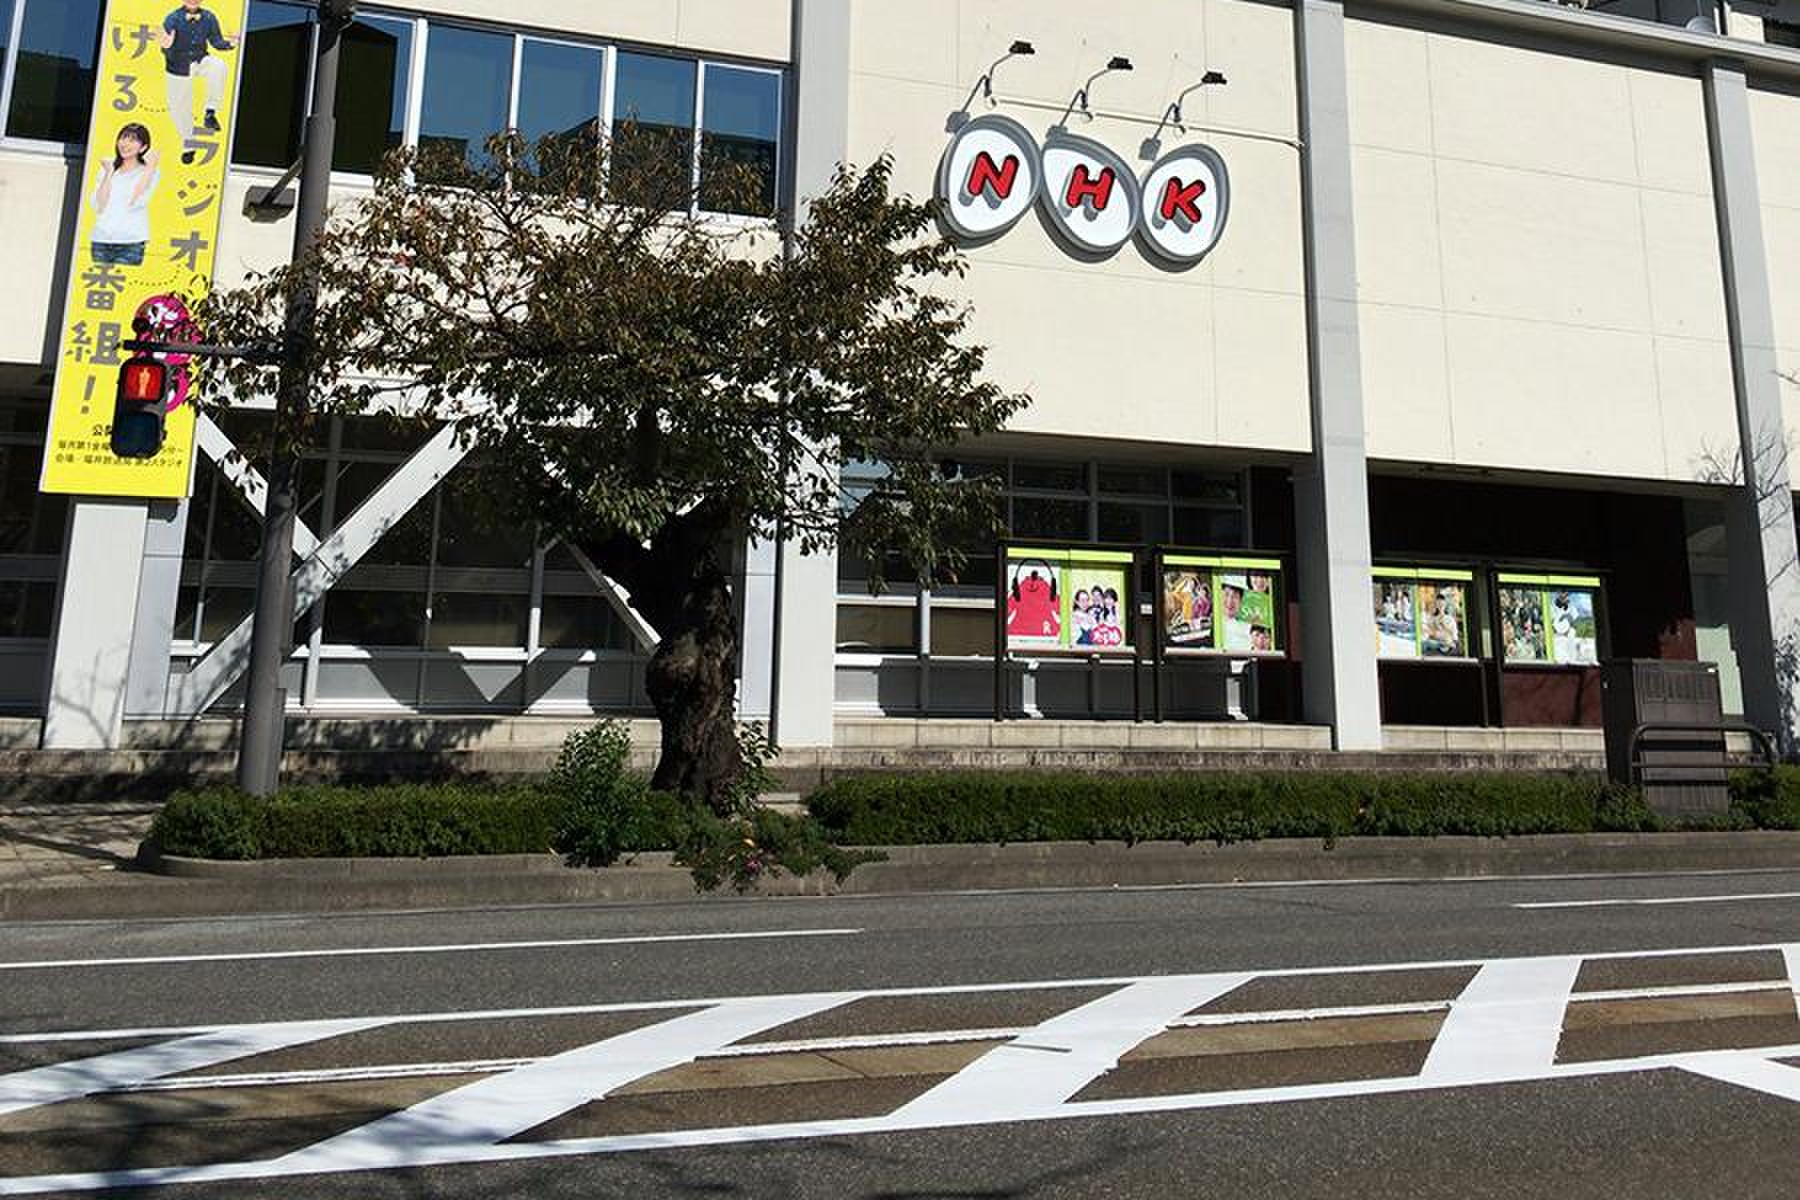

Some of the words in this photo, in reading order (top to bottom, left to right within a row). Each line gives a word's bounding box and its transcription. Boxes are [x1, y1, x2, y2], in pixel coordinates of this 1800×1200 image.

[169, 126, 220, 272] ラジオ
[964, 150, 1208, 225] NHK
[65, 263, 127, 415] 番組!
